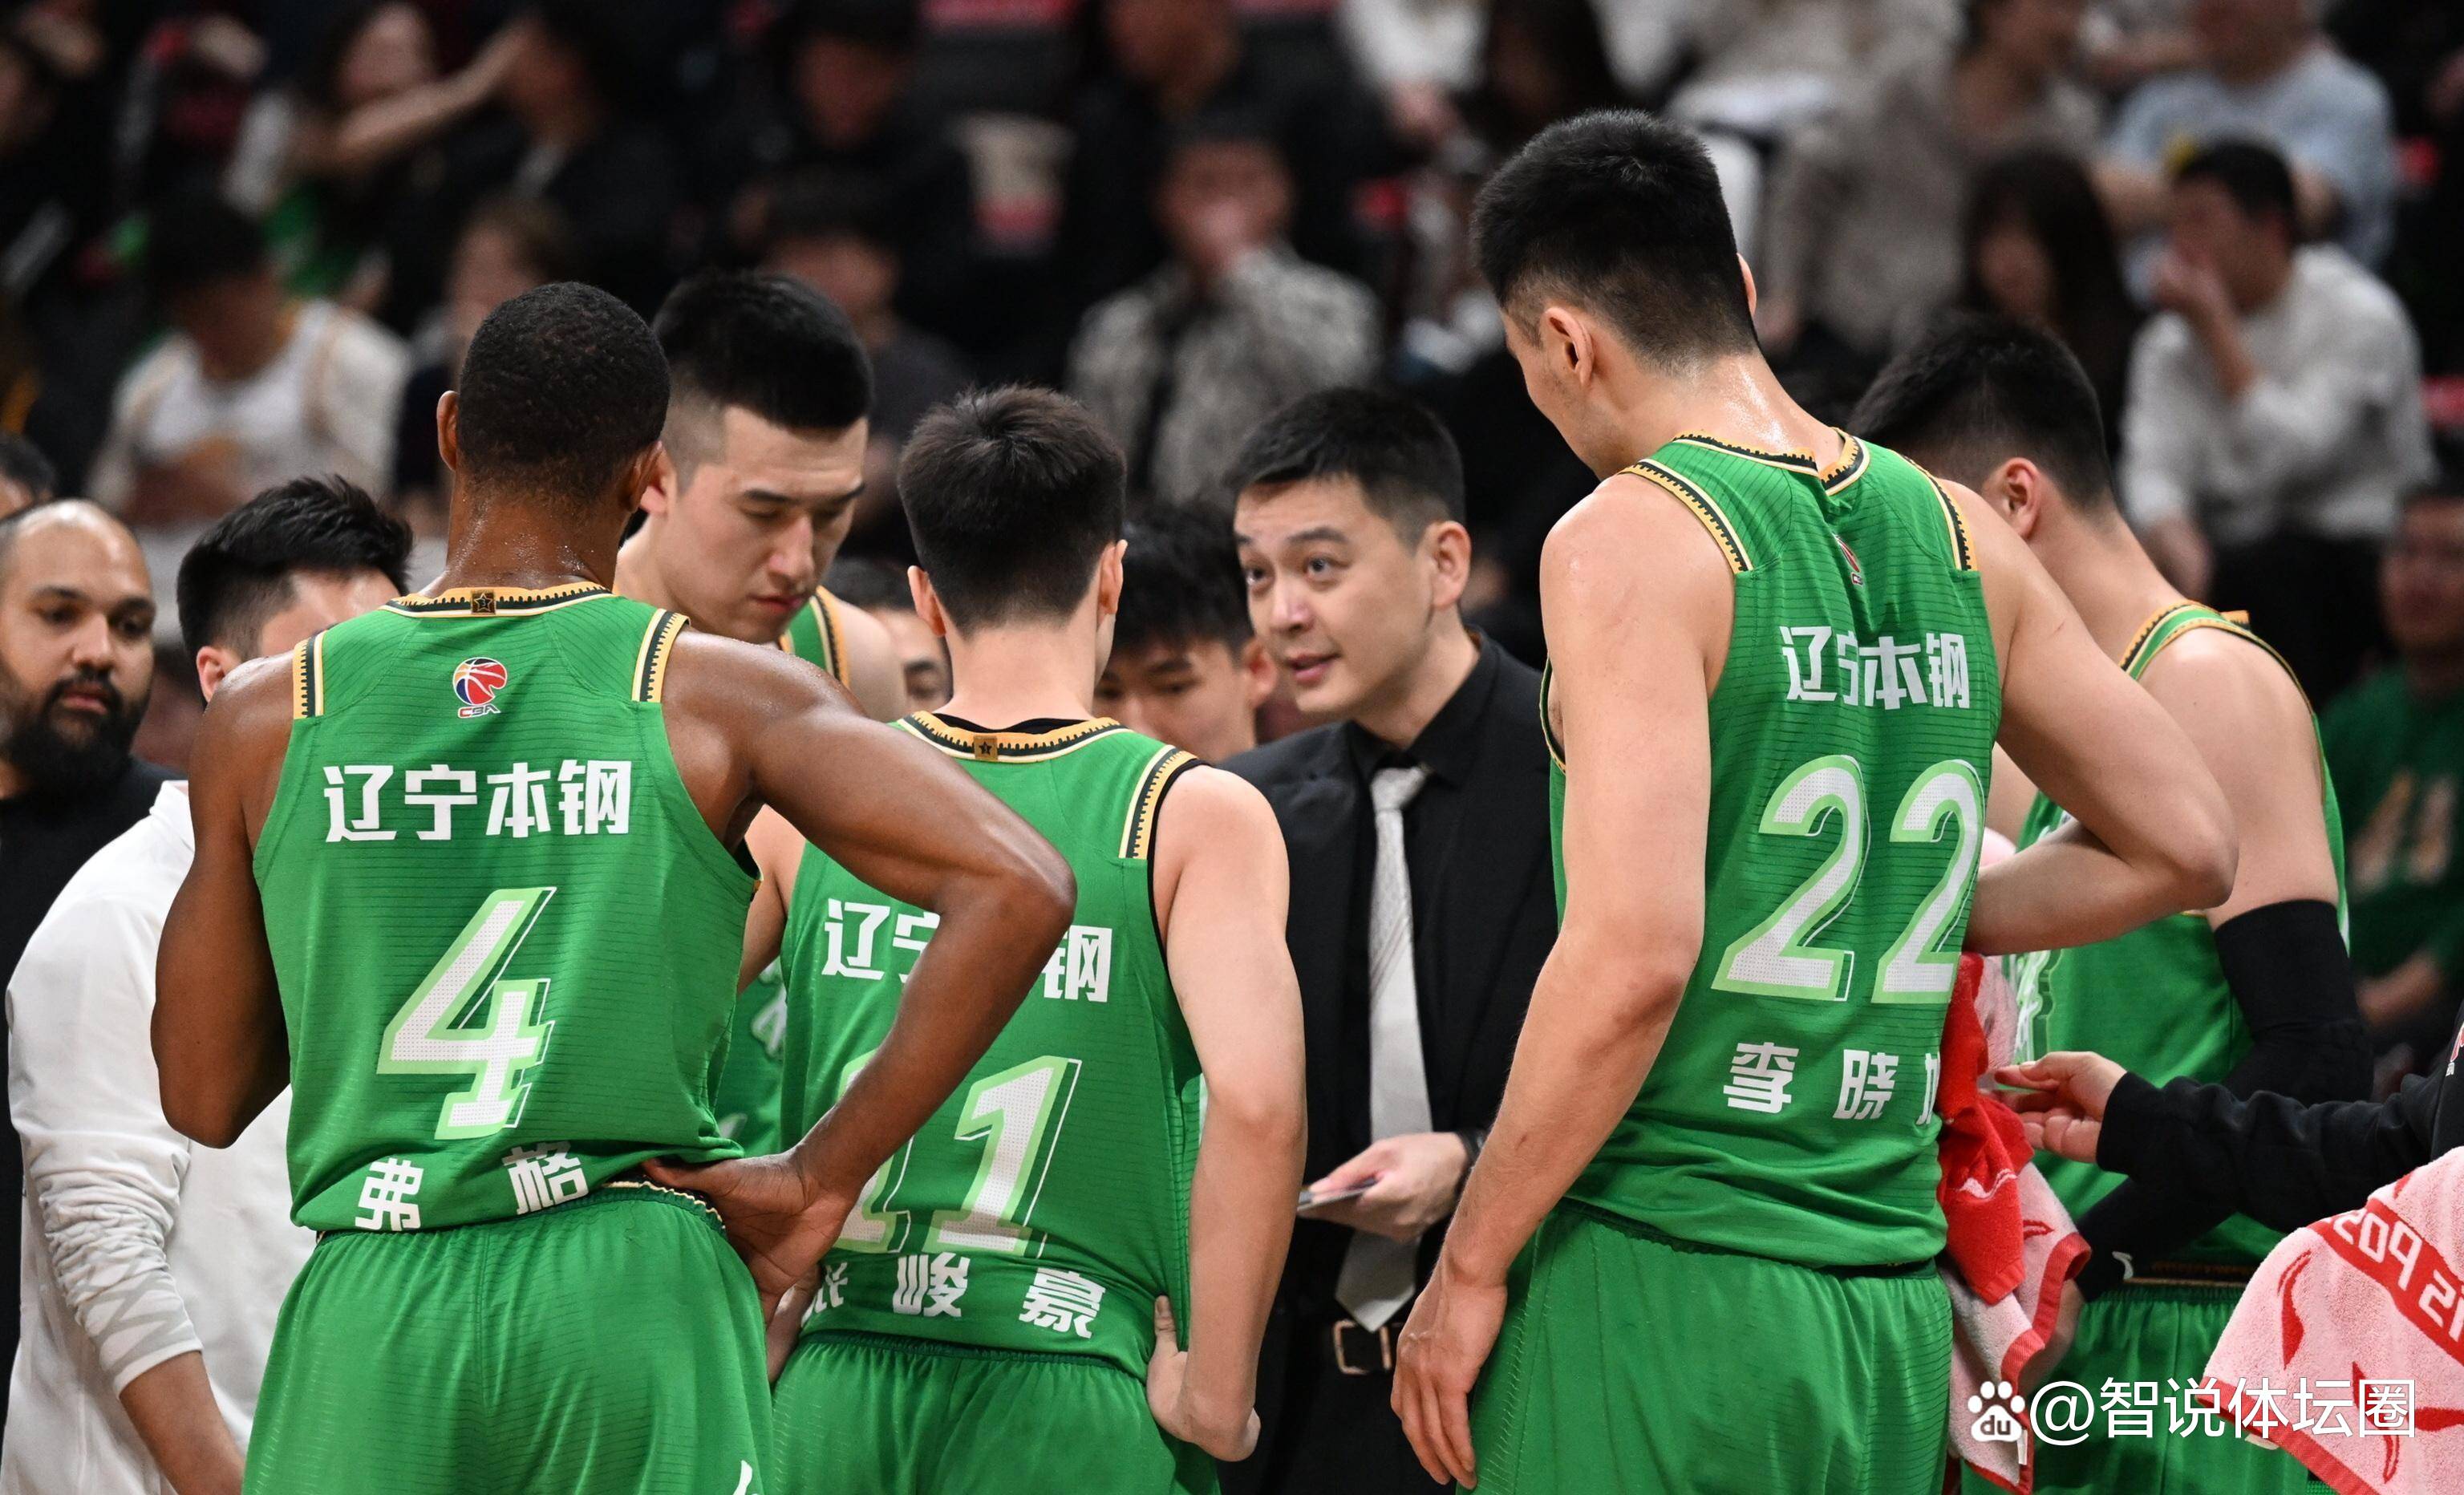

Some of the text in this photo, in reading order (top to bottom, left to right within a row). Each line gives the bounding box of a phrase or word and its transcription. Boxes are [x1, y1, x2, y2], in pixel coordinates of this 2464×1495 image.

[458, 703, 501, 719] CBA
[322, 760, 632, 842] 辽宁本钢
[1711, 755, 1986, 1004] 22
[377, 886, 557, 1140] 4
[355, 1140, 589, 1232] 弗格
